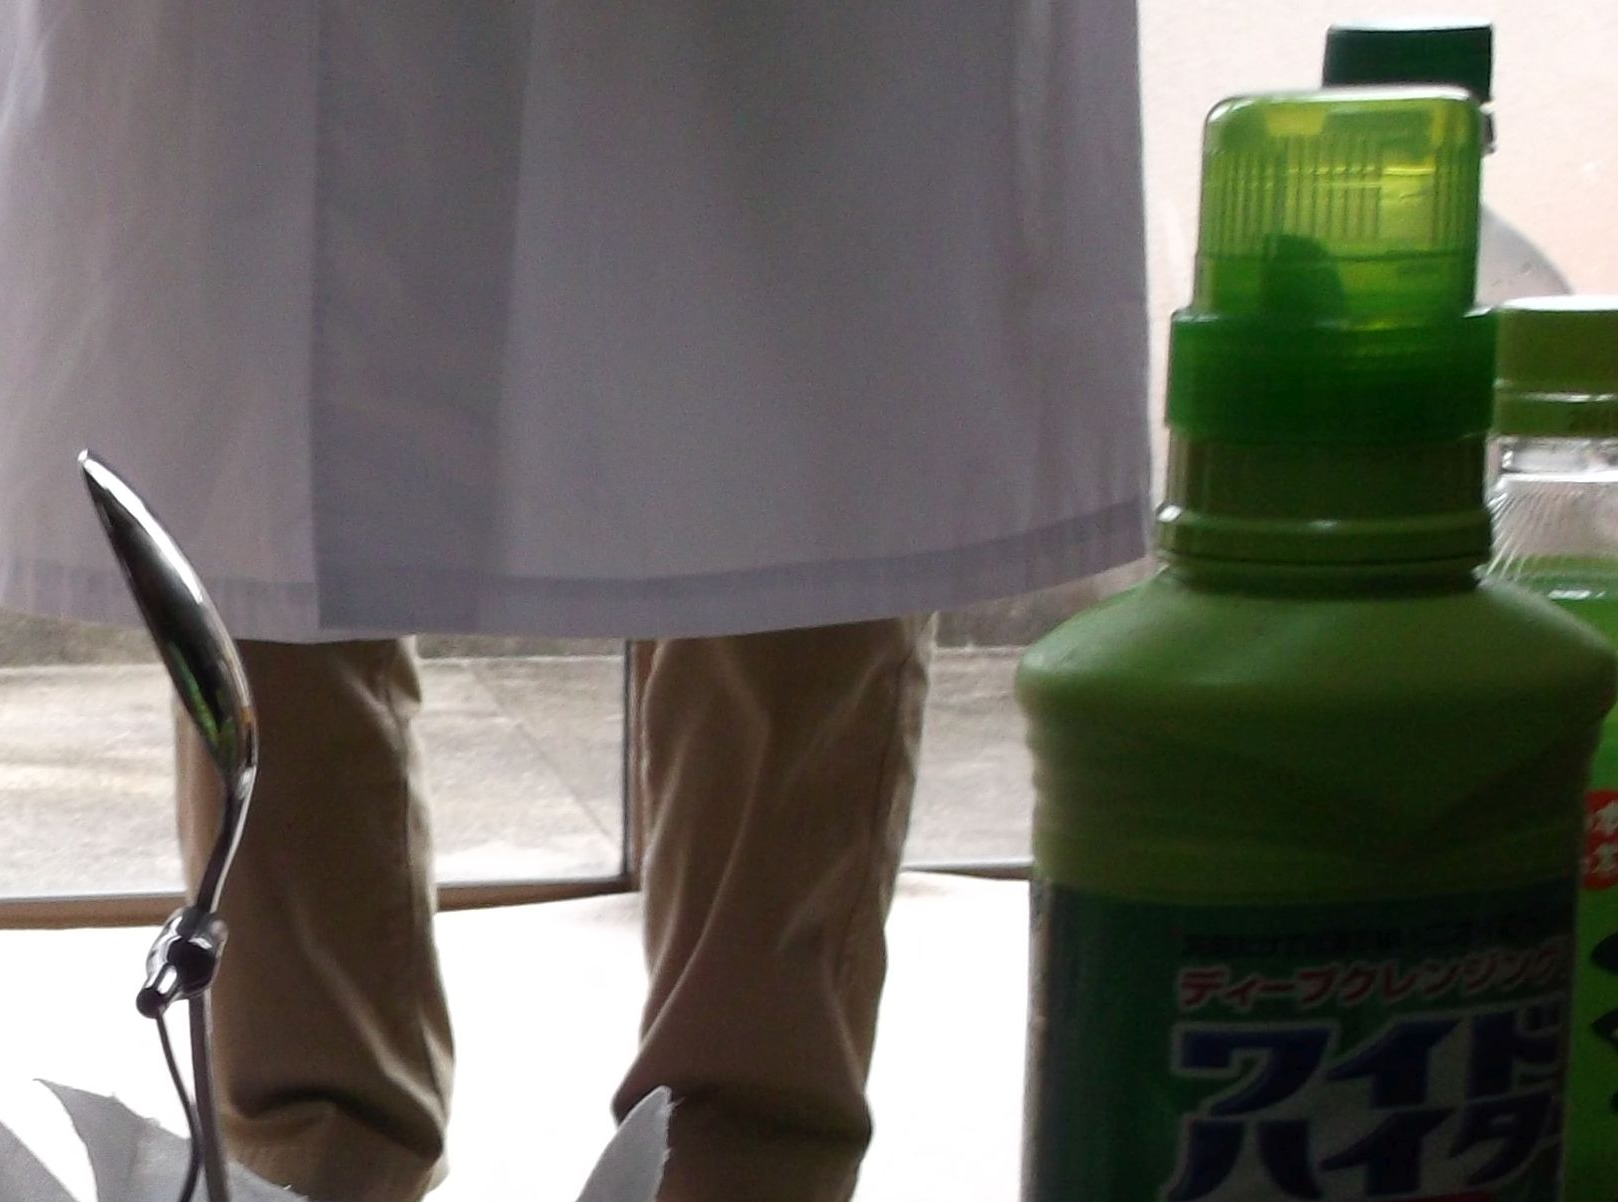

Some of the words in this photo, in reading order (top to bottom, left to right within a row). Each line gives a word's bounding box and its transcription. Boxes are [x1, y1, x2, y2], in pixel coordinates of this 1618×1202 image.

[1177, 1001, 1560, 1118] ワイド
[1166, 1090, 1562, 1202] ハイタ
